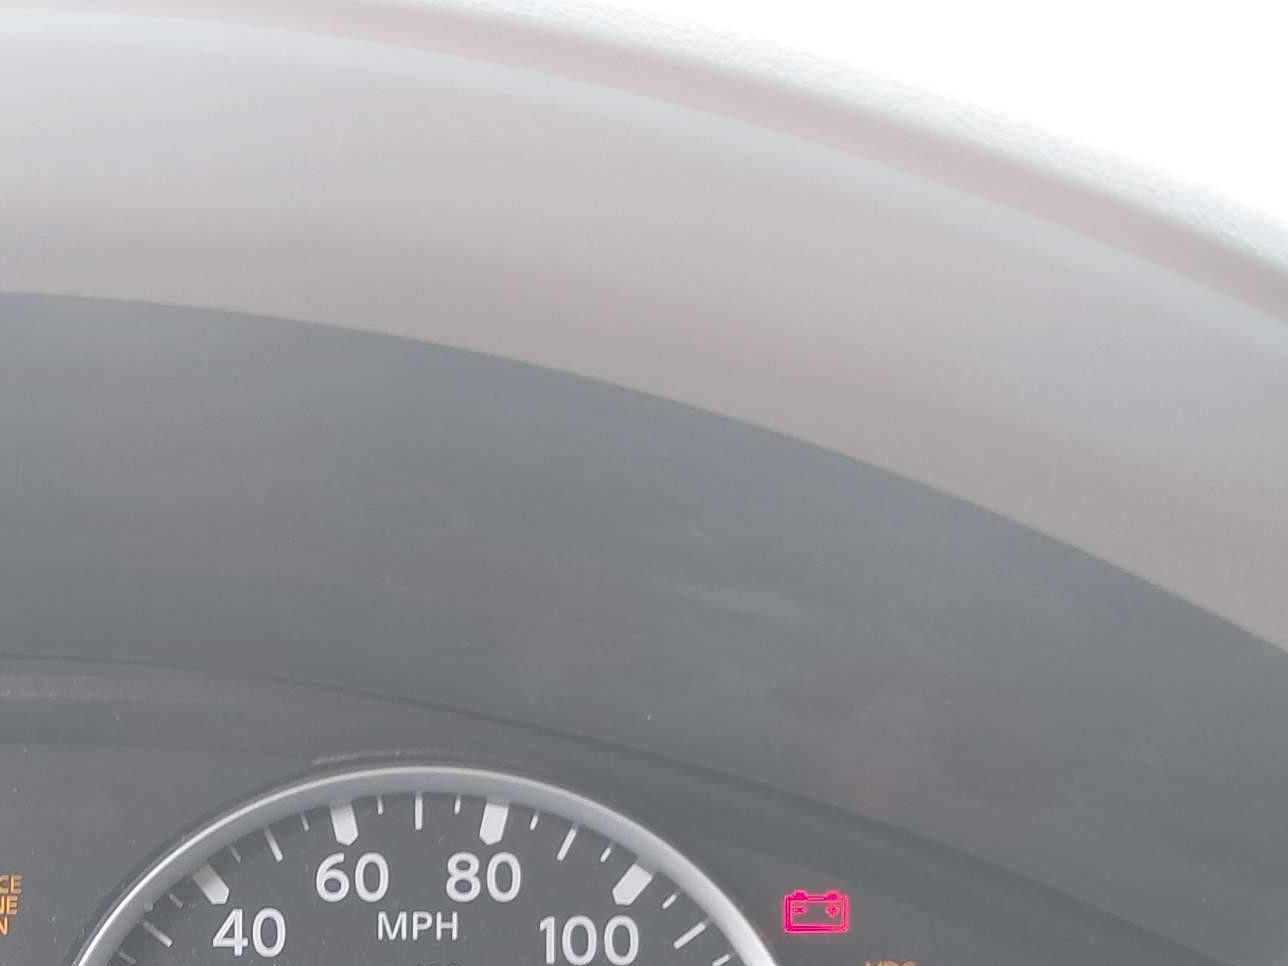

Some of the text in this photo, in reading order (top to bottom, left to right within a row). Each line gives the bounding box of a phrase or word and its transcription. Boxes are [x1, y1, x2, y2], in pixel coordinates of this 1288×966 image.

[315, 852, 388, 902] 60
[446, 852, 521, 902] 80
[212, 907, 286, 958] 40
[377, 911, 458, 942] MPH
[540, 915, 640, 966] 100
